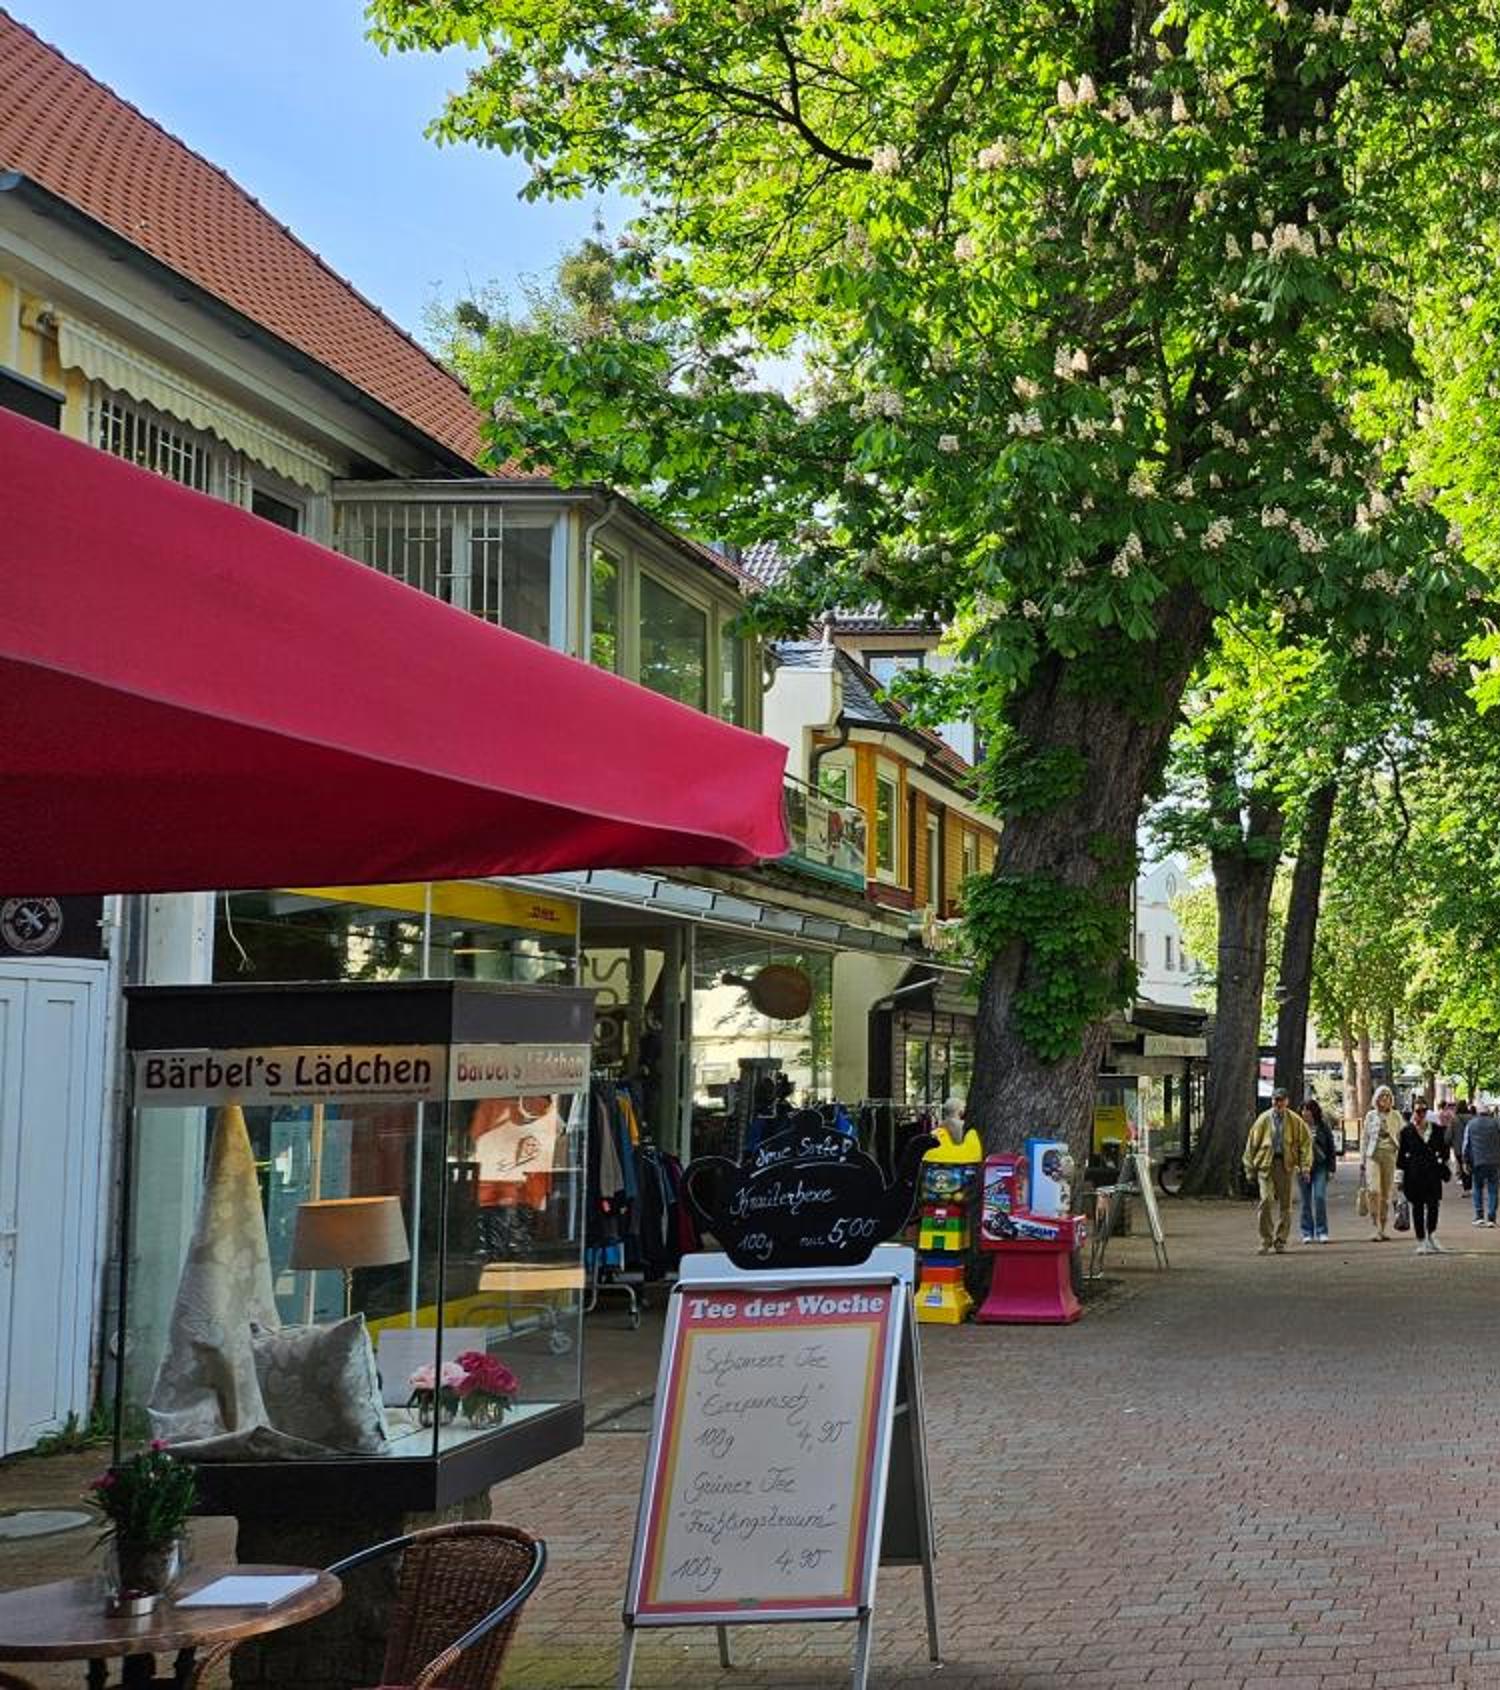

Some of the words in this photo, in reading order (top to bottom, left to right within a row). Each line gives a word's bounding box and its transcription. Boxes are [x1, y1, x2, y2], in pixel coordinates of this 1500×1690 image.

[145, 1055, 282, 1089] Bärbel's
[295, 1053, 431, 1086] Lädchen
[688, 1300, 737, 1319] Tee
[744, 1298, 791, 1317] der
[796, 1294, 884, 1315] Woche
[795, 1344, 830, 1369] Tee
[693, 1426, 735, 1458] 100g
[762, 1466, 798, 1493] Tee
